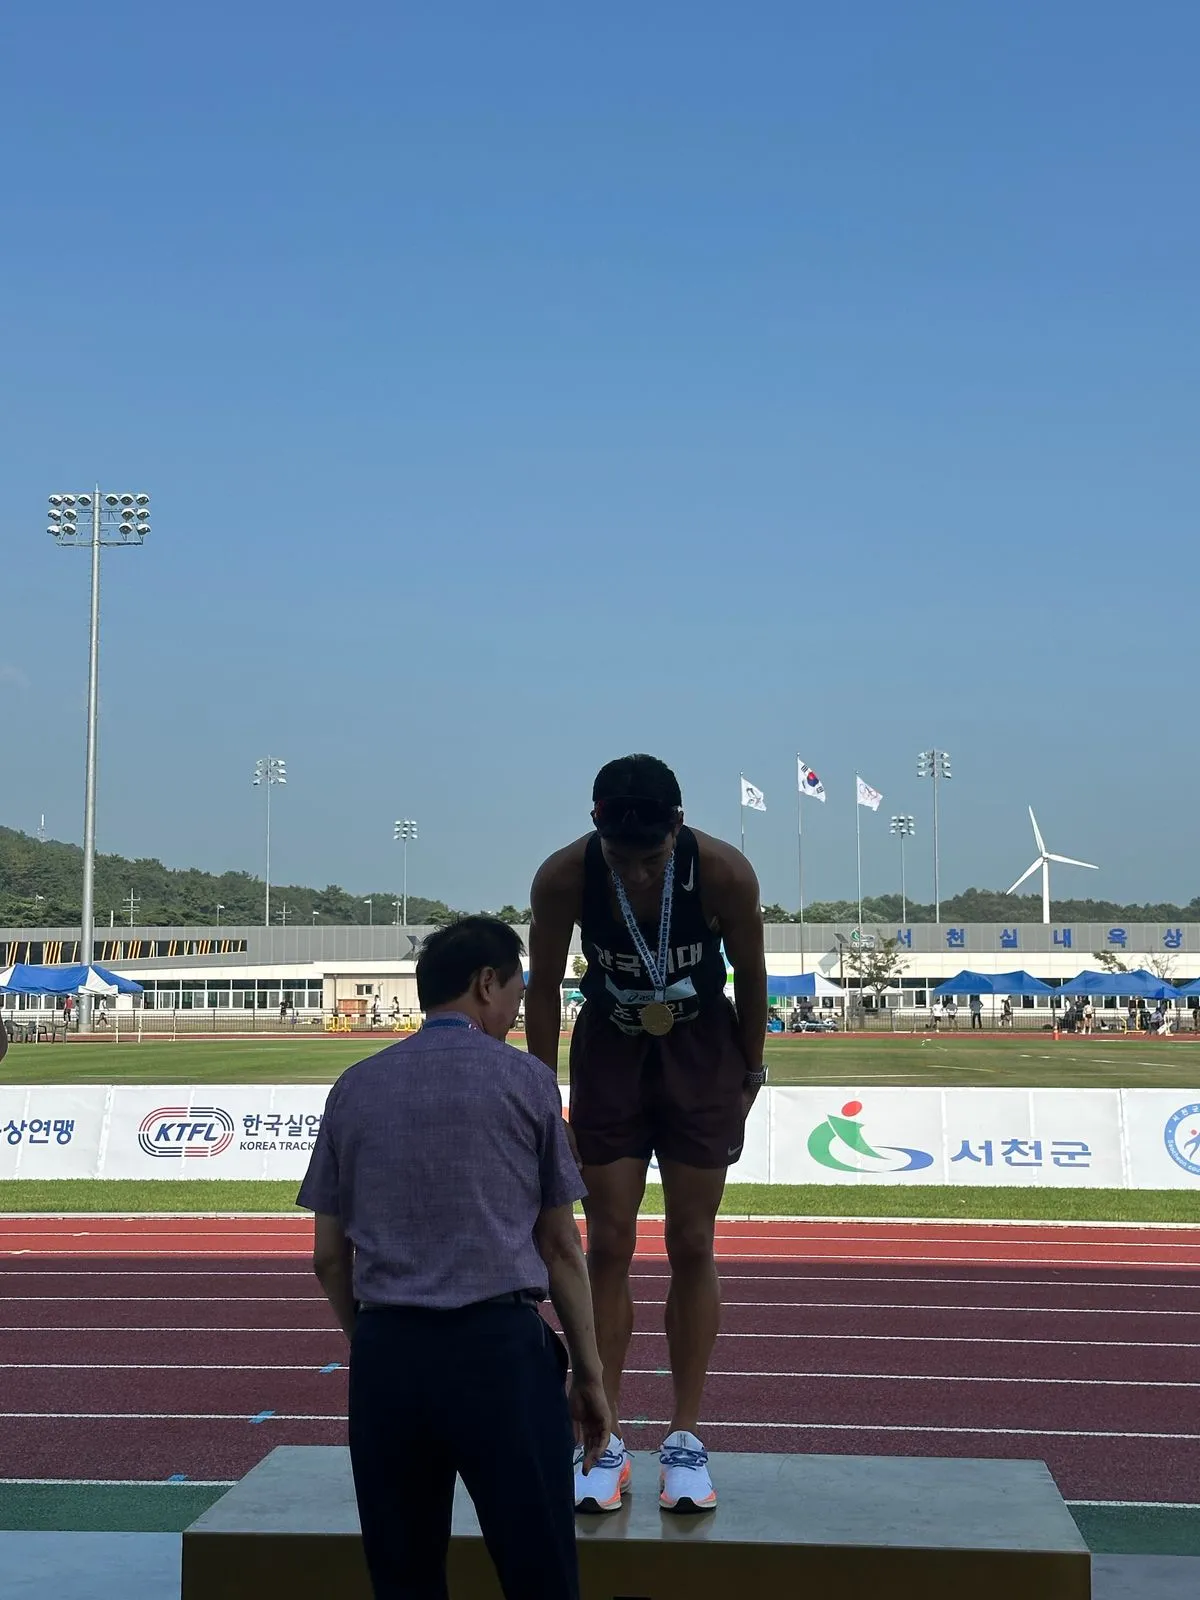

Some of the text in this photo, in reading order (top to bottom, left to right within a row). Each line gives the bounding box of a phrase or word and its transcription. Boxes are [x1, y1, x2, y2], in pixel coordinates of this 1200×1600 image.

[0, 1119, 75, 1145] 상연맹
[154, 1123, 219, 1142] KTFL
[239, 1141, 315, 1151] KOREA TRACK
[951, 1138, 1092, 1168] 서천군
